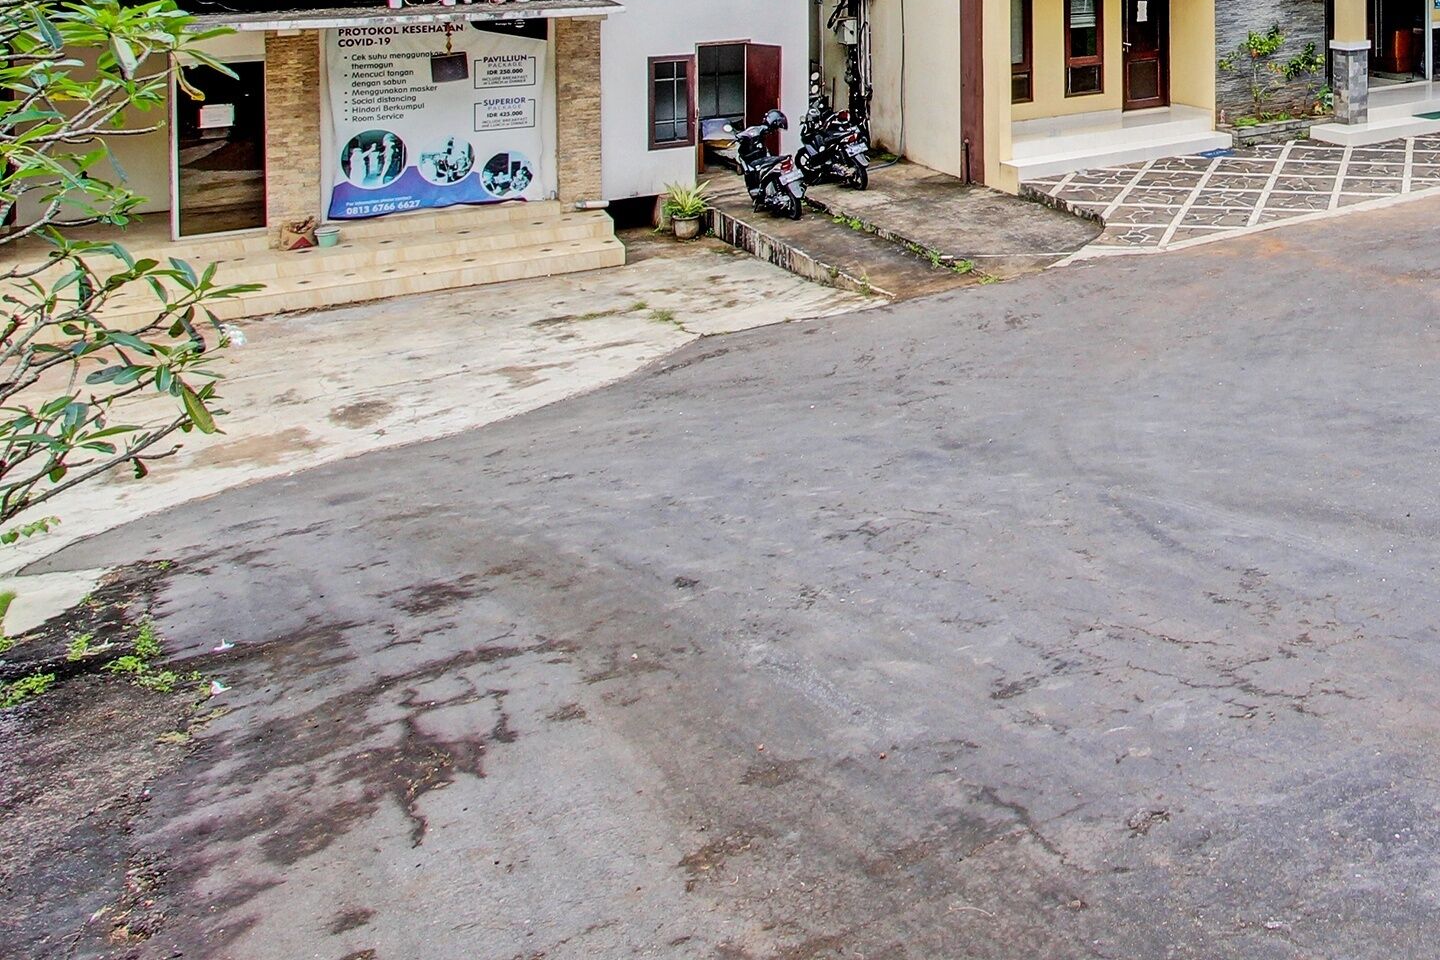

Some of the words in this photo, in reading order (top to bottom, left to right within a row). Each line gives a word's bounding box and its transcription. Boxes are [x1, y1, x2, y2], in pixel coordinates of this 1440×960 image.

[338, 27, 399, 36] PROTOKOL
[402, 24, 463, 34] KESEHATAN
[338, 37, 390, 47] COVID-19
[483, 54, 527, 63] PAVILLIUN
[352, 88, 408, 96] Menggunakan
[484, 97, 526, 106] SUPERIOR
[384, 103, 424, 111] Berkumpul
[346, 206, 370, 215] 0813
[372, 203, 395, 212] 6766
[398, 200, 420, 209] 6627
